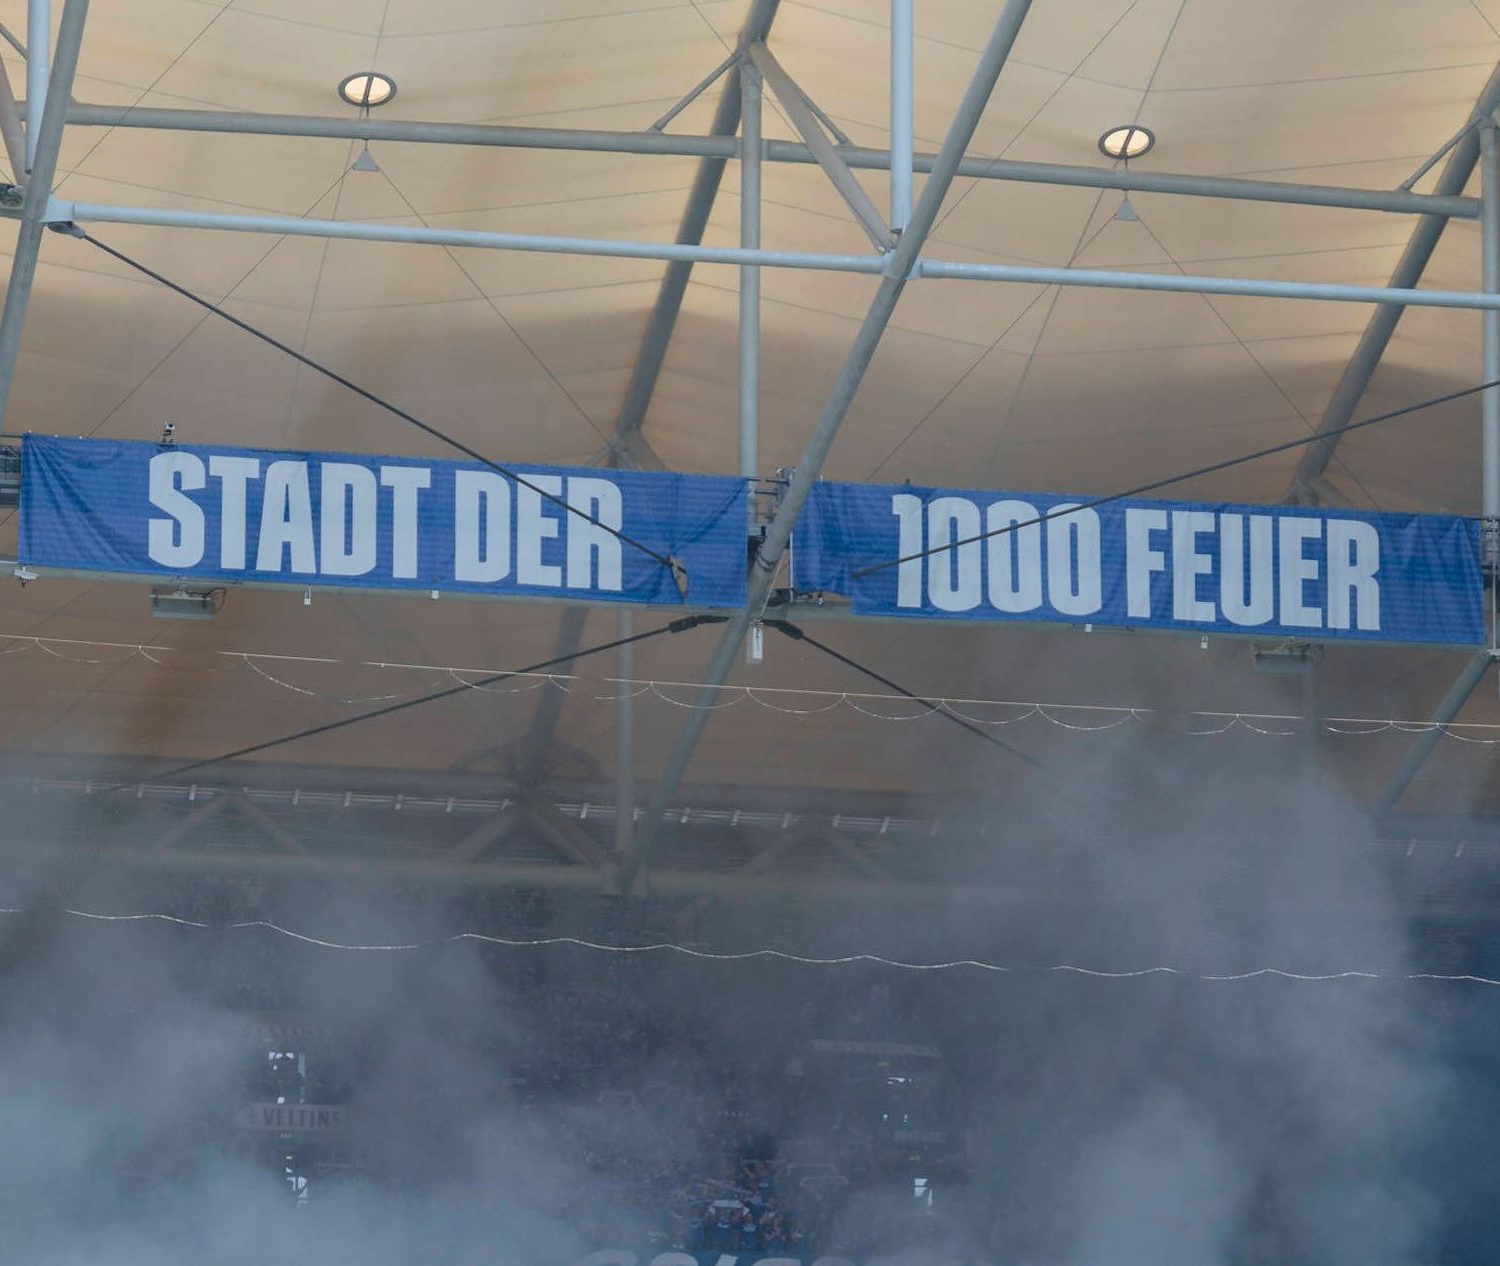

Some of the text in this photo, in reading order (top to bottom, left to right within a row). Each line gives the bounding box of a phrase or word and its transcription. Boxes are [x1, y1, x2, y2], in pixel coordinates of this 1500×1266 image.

[148, 451, 623, 591] STADT DER
[892, 494, 1380, 631] 1000 FEUER
